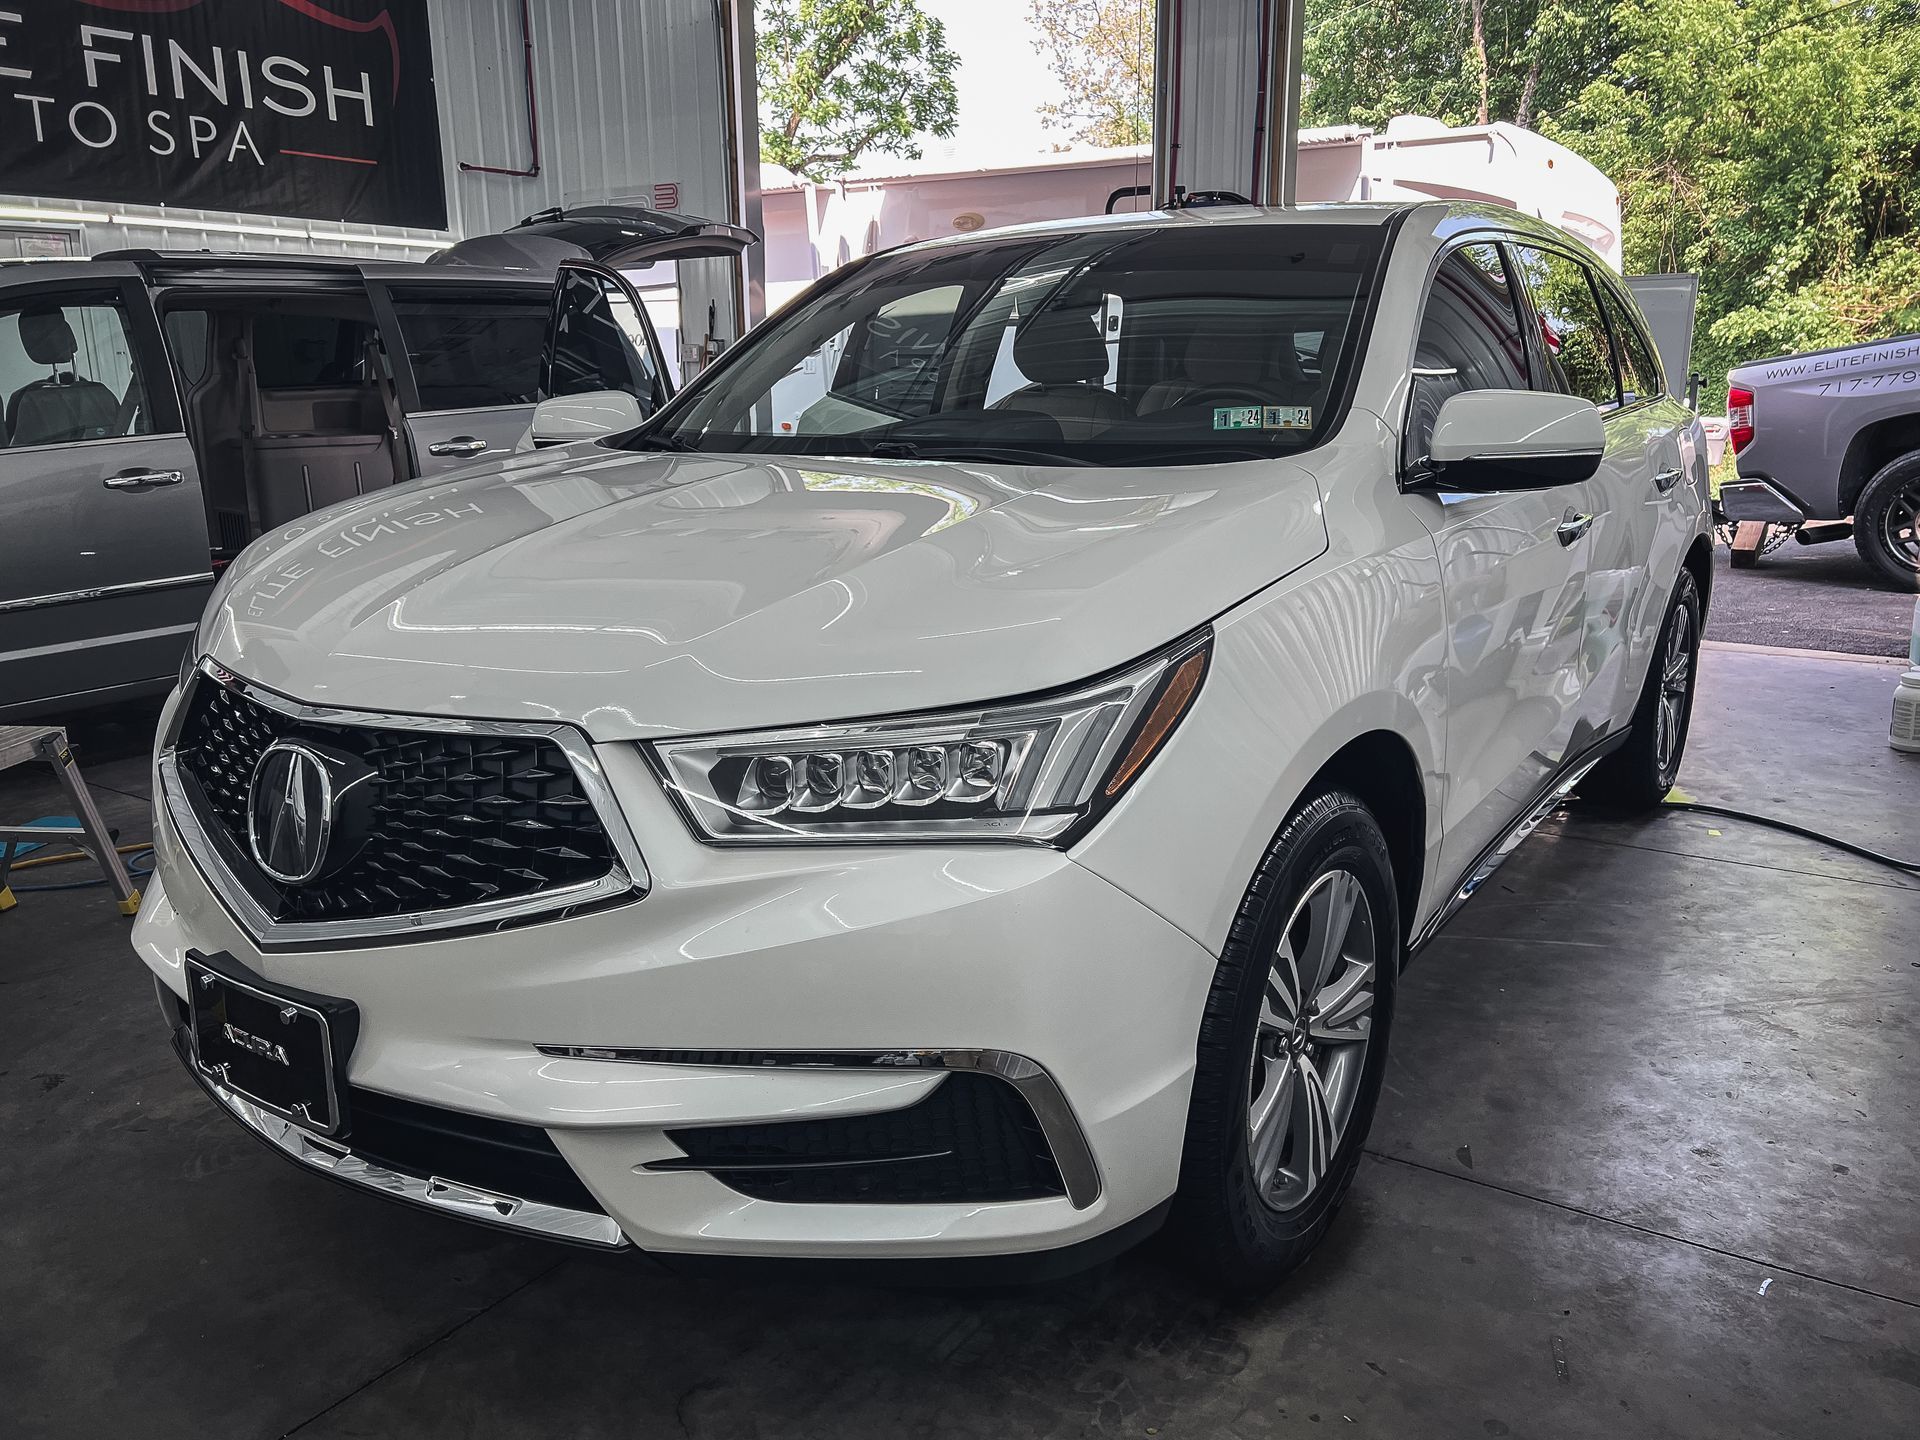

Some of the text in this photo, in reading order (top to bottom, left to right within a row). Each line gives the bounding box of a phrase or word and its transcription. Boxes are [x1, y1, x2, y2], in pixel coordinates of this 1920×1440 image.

[80, 24, 374, 127] FINISH
[148, 110, 265, 166] SPA
[1248, 409, 1259, 424] 24
[1297, 409, 1309, 424] 24
